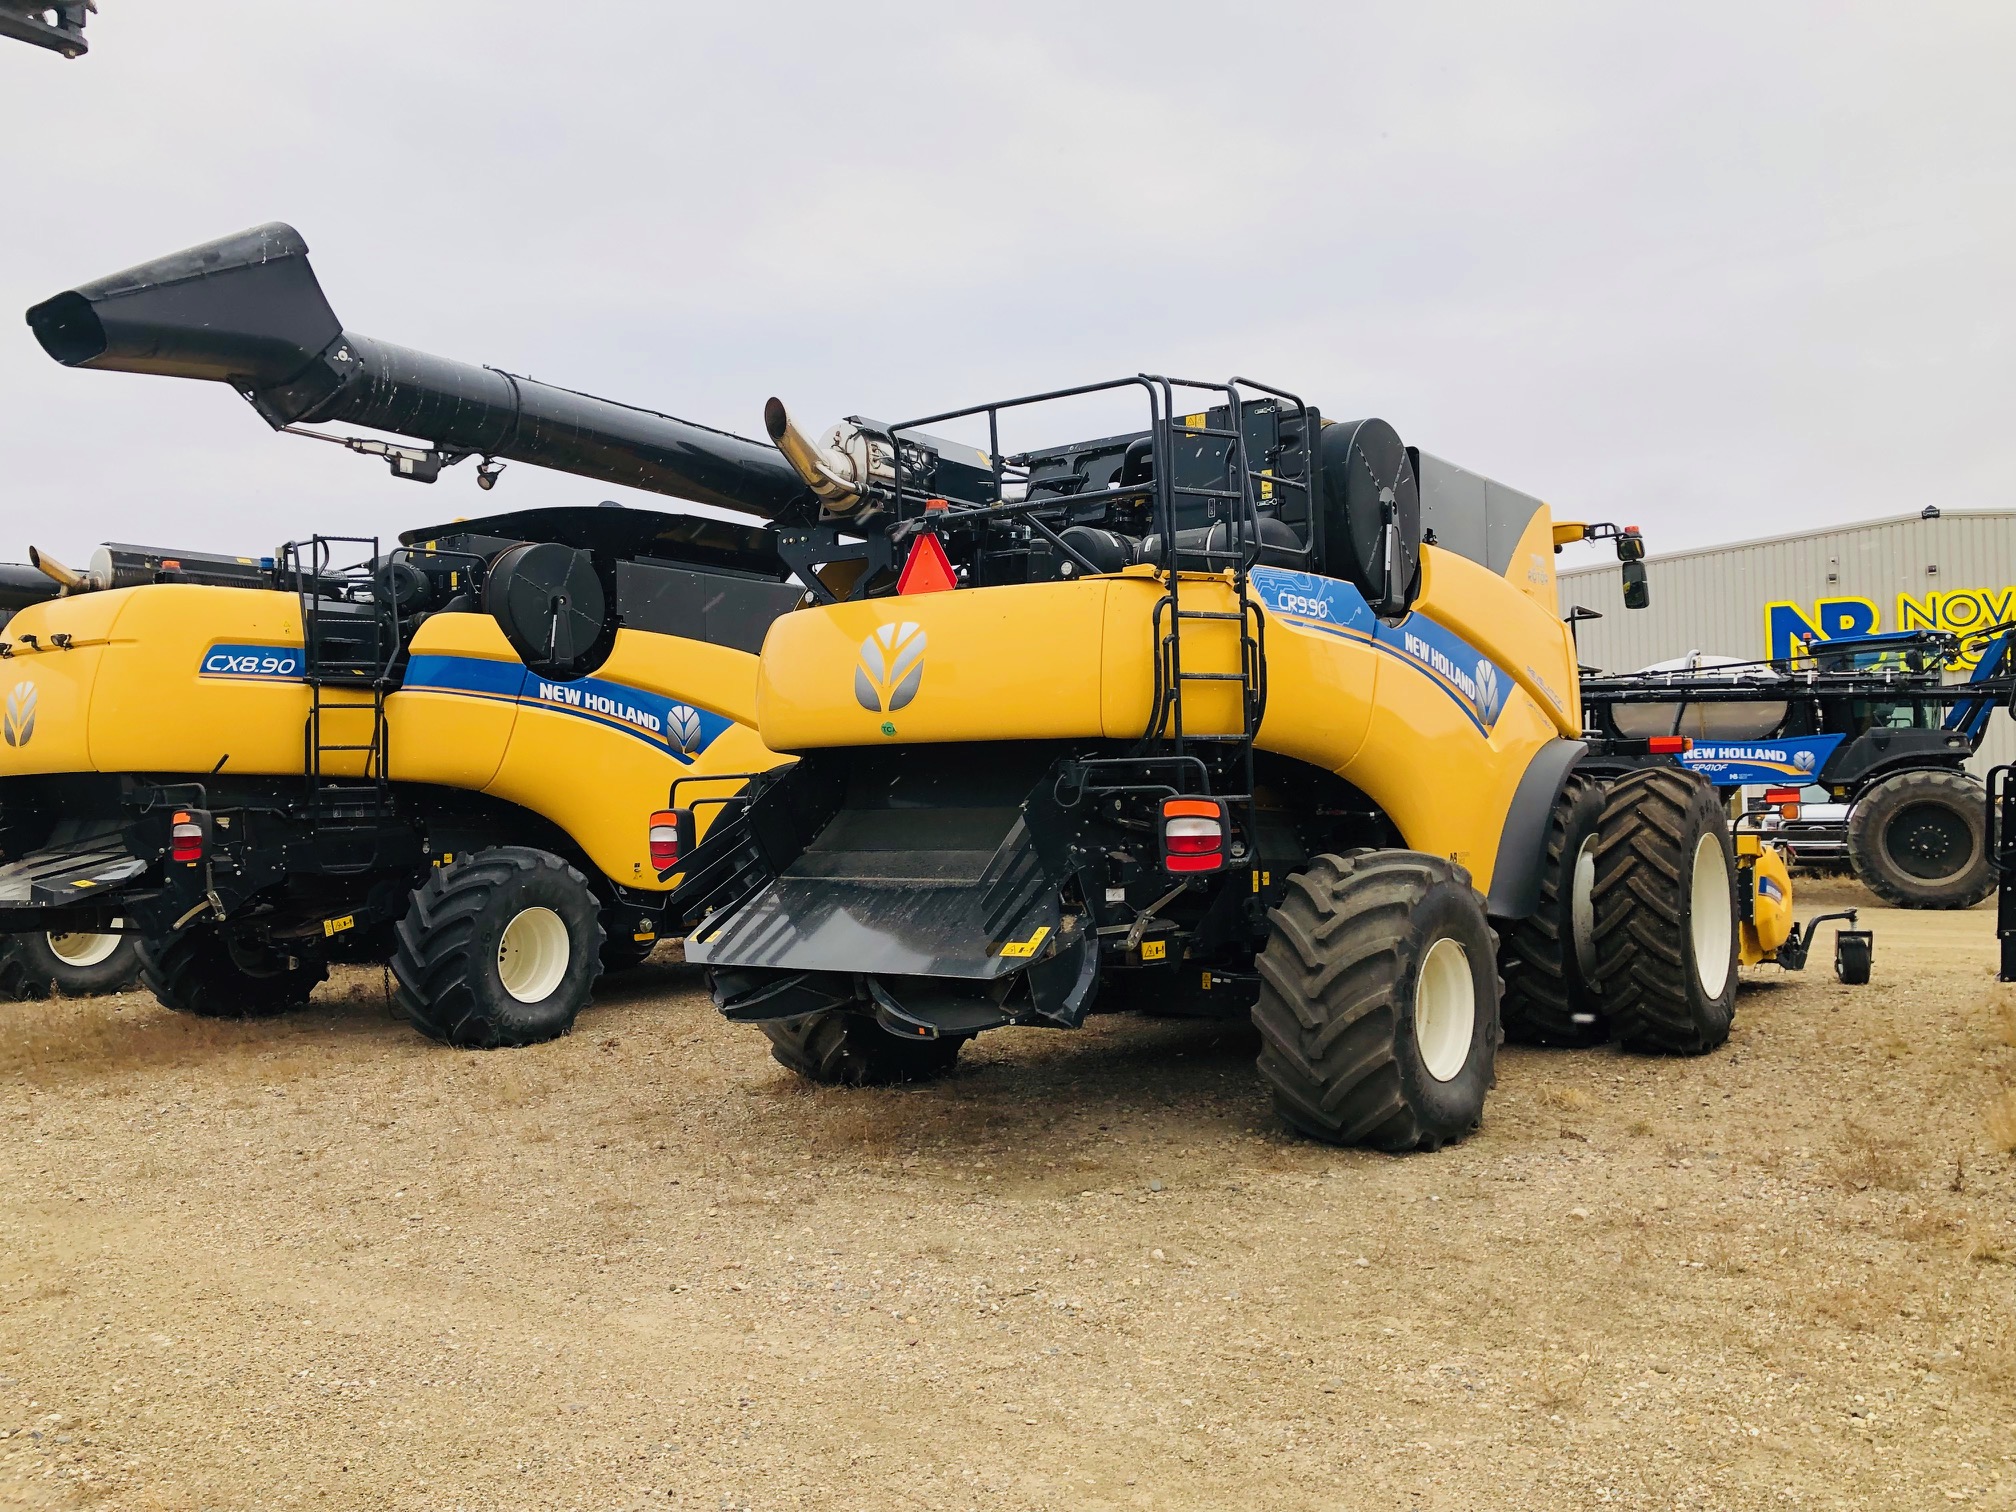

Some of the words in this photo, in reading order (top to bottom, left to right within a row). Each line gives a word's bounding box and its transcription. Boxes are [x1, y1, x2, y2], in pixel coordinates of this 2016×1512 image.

[1278, 592, 1328, 618] CR9.90
[1898, 587, 2016, 632] NOV
[206, 654, 296, 674] CX8.90
[1405, 631, 1430, 662] NEW
[1431, 647, 1475, 700] HOLLAND
[539, 682, 582, 705] NEW
[584, 692, 661, 732] HOLLAND
[1683, 748, 1716, 759] NEW
[1718, 748, 1787, 762] HOLLAND
[1691, 763, 1729, 772] SP410F
